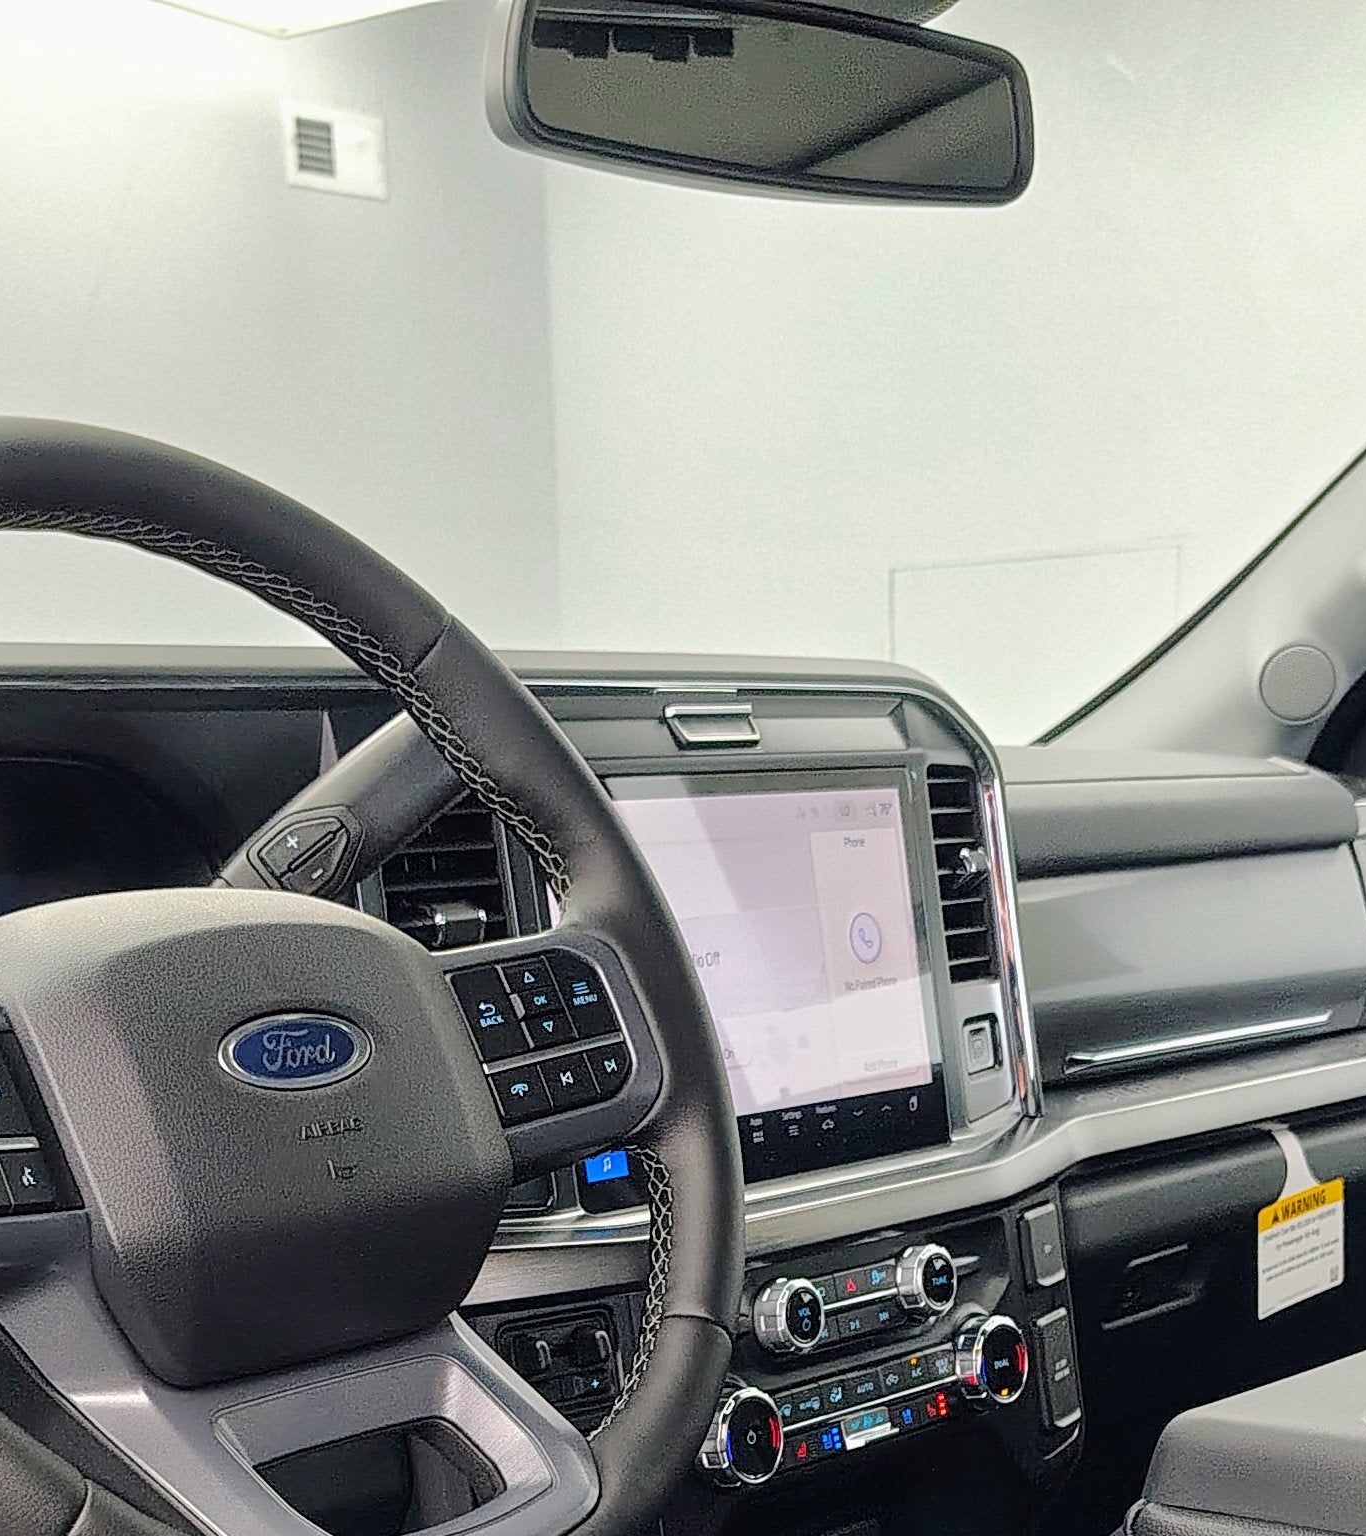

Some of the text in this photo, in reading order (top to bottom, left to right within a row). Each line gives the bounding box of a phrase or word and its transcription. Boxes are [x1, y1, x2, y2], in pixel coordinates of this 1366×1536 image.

[533, 995, 548, 1006] OK
[572, 993, 598, 1007] MENU
[479, 1014, 505, 1028] BACK
[262, 1028, 336, 1072] Ford
[1280, 1188, 1326, 1221] WARNING
[798, 1307, 812, 1318] VOL
